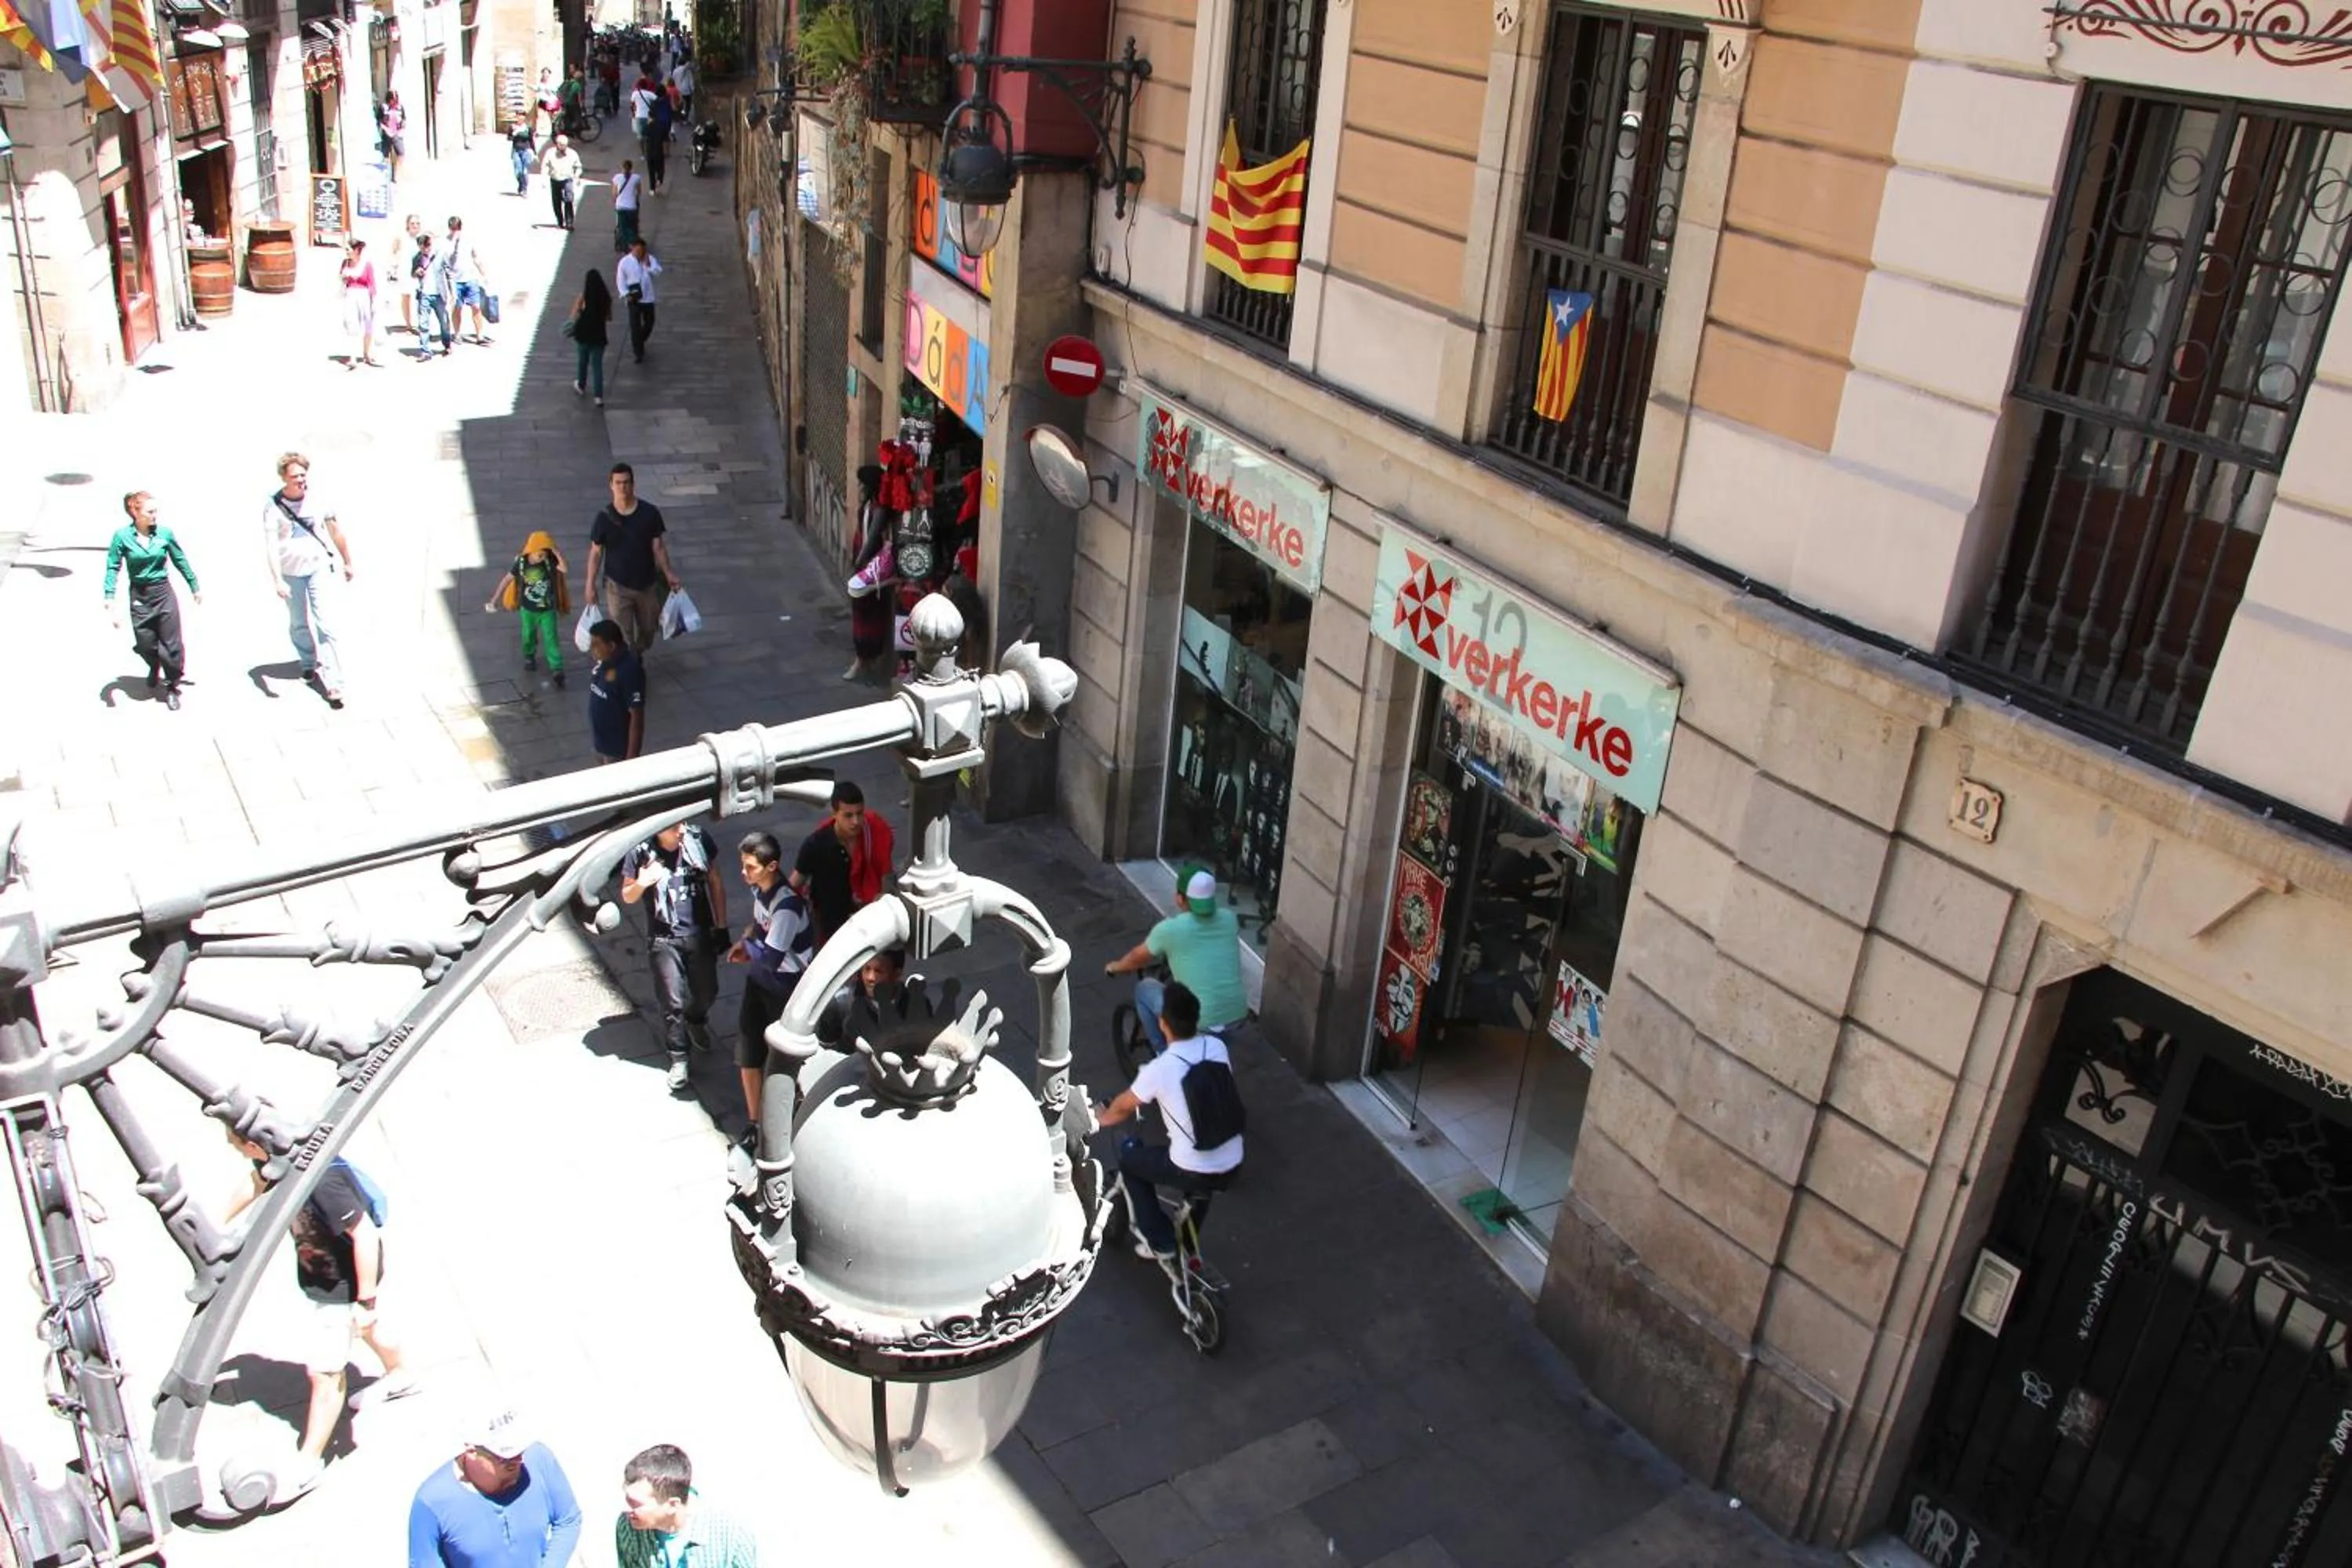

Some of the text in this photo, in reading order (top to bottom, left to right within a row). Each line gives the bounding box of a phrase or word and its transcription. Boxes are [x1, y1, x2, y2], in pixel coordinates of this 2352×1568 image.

[1185, 463, 1304, 568] verkerke
[1446, 623, 1633, 777] verkerke
[1958, 790, 1990, 829] 12
[351, 1022, 415, 1093] BARCELONA
